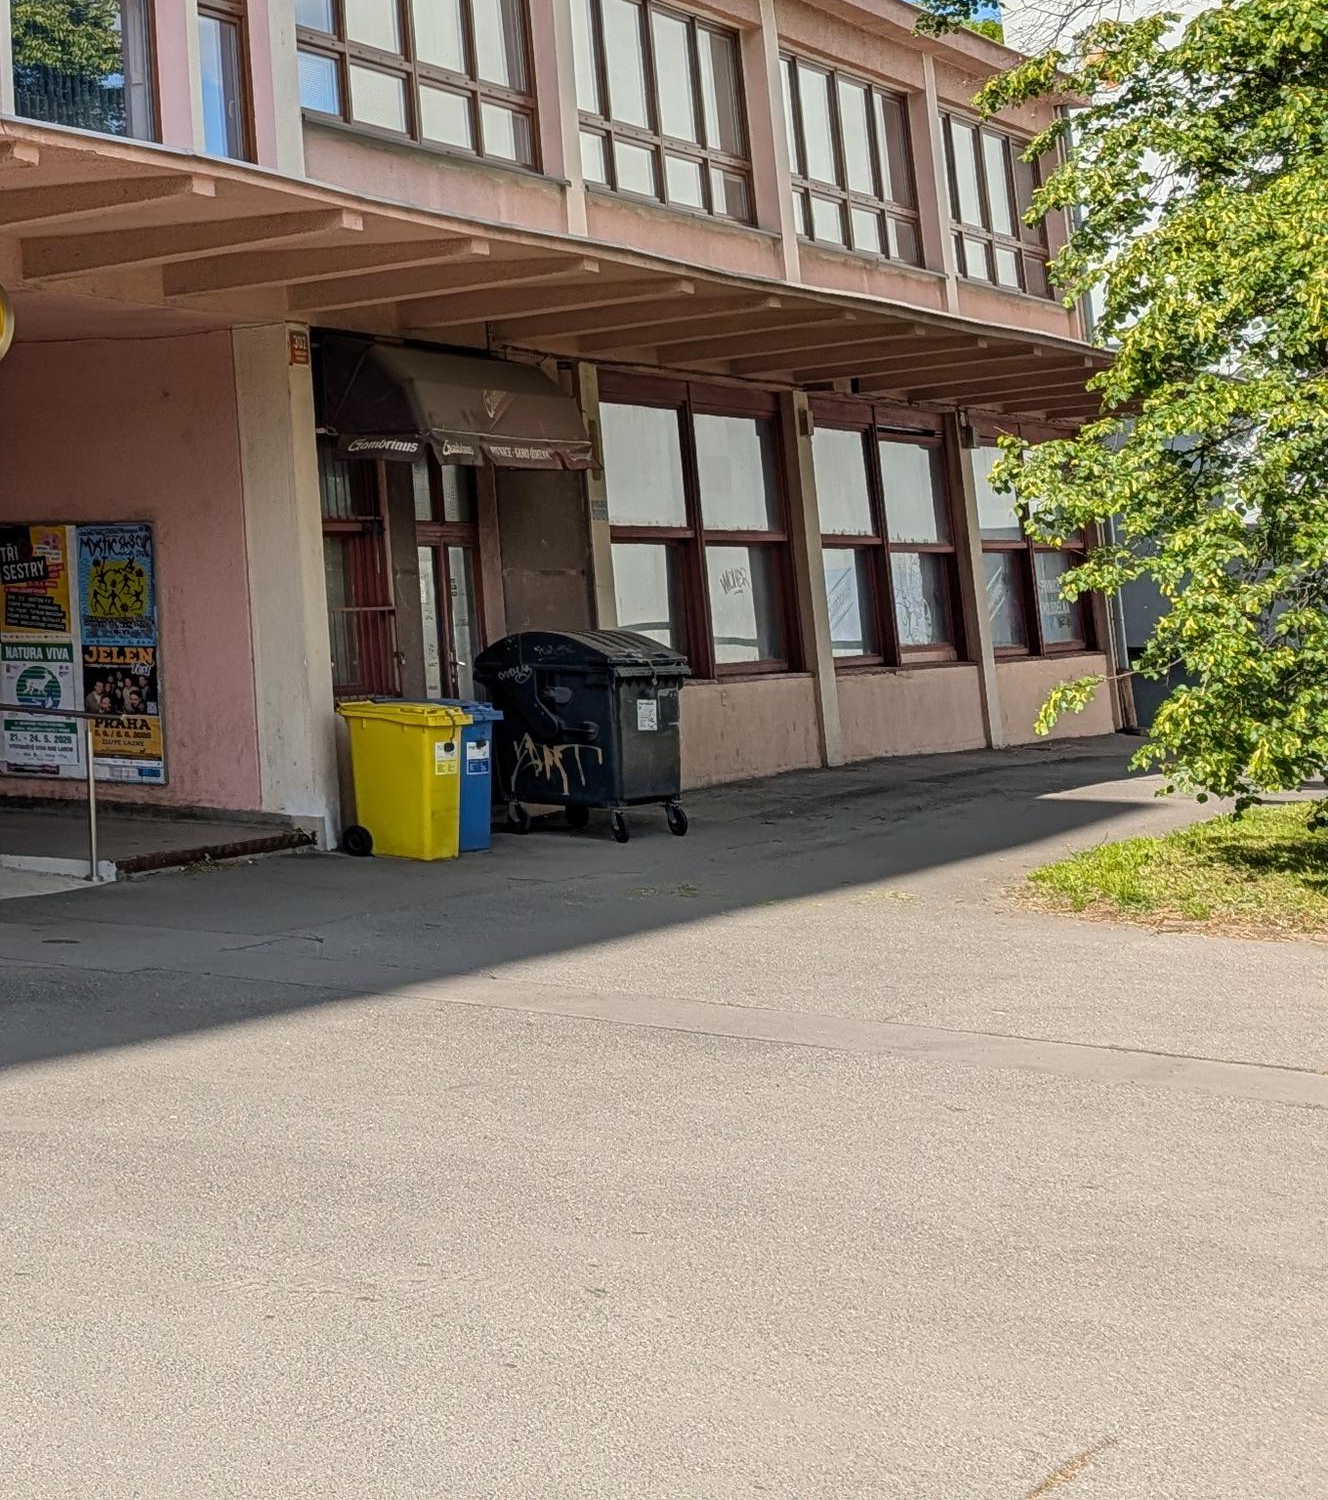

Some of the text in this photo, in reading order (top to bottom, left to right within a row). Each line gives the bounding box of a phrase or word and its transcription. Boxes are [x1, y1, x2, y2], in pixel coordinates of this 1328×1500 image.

[347, 437, 419, 453] Gambrinus
[0, 543, 19, 563] TŘI
[2, 560, 45, 581] SESTRY
[4, 645, 43, 660] NATURA
[45, 647, 69, 661] VIVA
[84, 646, 154, 664] JELEN
[94, 717, 151, 731] PRAHA
[9, 733, 21, 742] 21.
[29, 734, 41, 743] 24.
